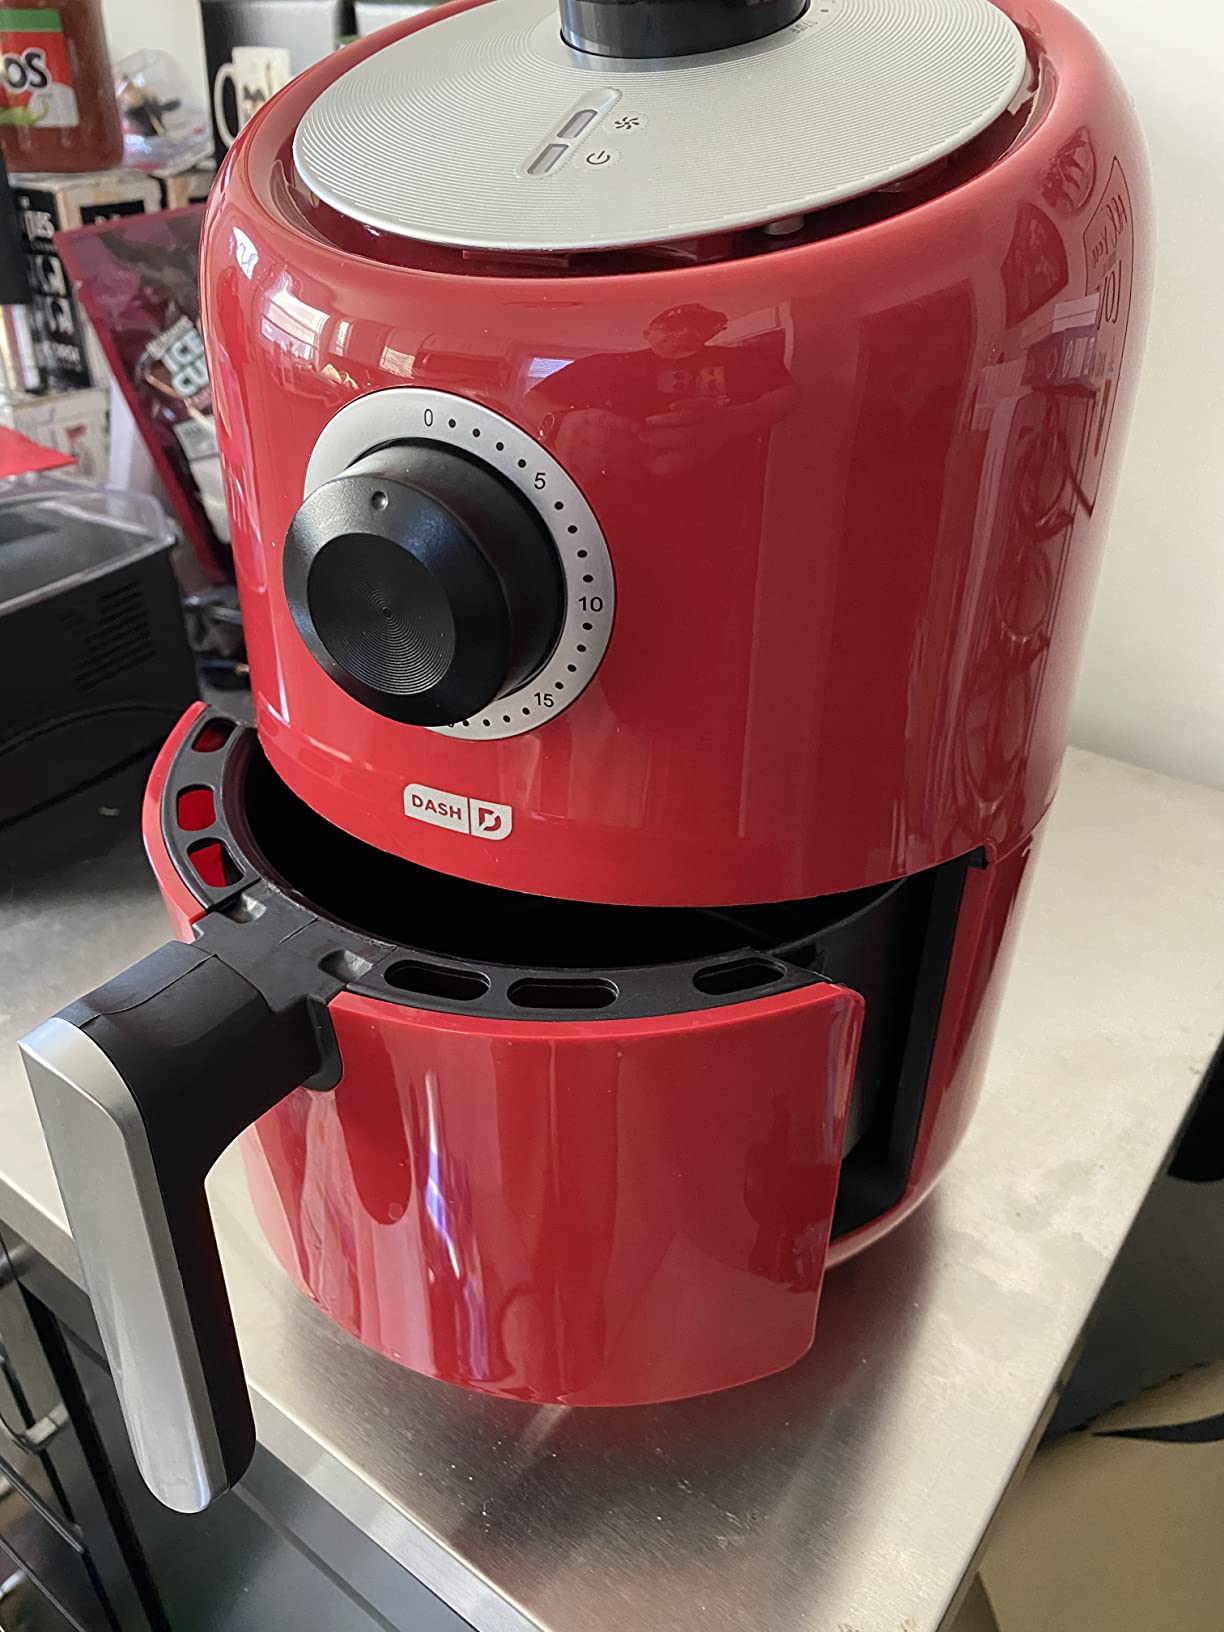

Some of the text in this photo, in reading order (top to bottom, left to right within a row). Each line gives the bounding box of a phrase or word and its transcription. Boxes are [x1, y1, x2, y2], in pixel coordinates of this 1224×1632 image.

[4, 52, 47, 88] OS
[423, 409, 433, 427] 0
[534, 472, 547, 490] 5
[578, 596, 603, 612] 10
[534, 692, 554, 708] 15
[411, 794, 462, 820] DASH
